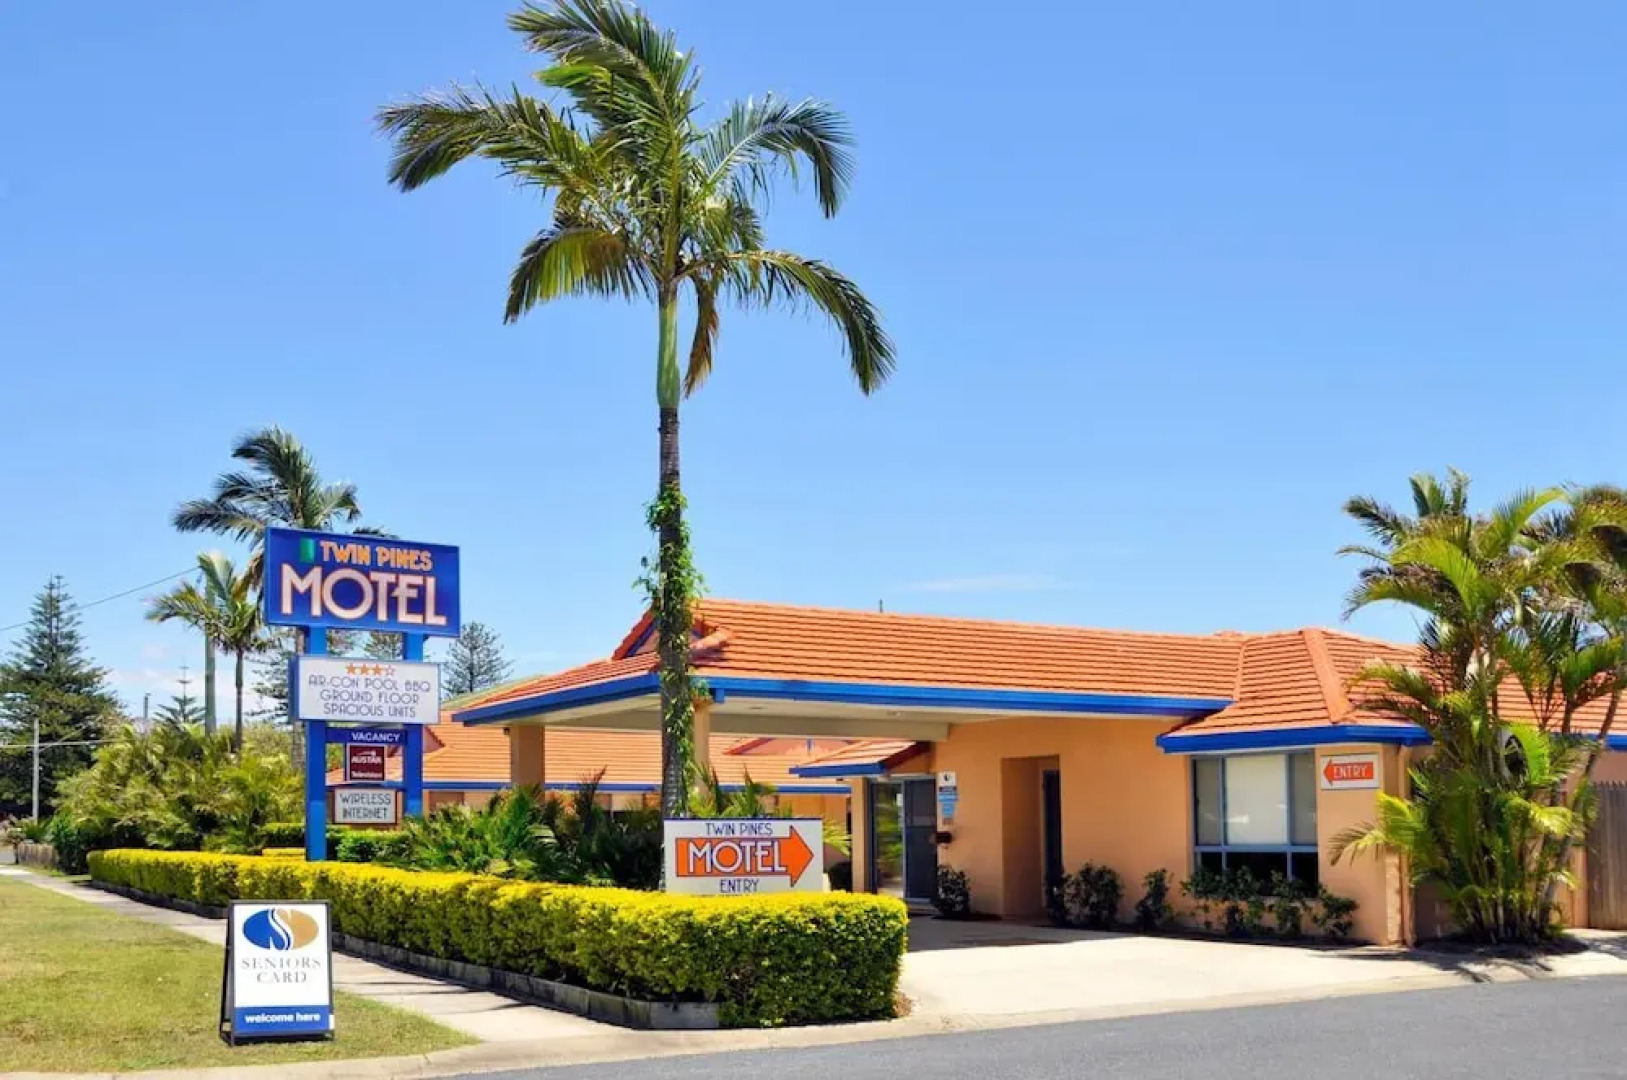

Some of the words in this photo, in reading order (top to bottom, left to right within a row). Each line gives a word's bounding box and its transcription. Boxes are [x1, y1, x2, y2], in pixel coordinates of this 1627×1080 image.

[320, 540, 370, 565] TWIN
[376, 547, 432, 571] PINES
[281, 563, 447, 625] MOTEL
[365, 678, 399, 691] POOL
[404, 680, 431, 692] BBQ
[320, 689, 373, 703] GROUND
[378, 693, 419, 704] FLOOR
[323, 702, 384, 717] SPACIOUS
[388, 706, 416, 718] UNITS
[351, 732, 400, 742] VACANCY
[1333, 765, 1368, 779] ENTRY
[340, 794, 391, 805] WIRELESS
[343, 807, 387, 818] INTERNET
[705, 822, 735, 835] TWIN
[739, 822, 773, 835] PINES
[688, 841, 787, 873] MOTEL
[720, 879, 759, 893] ENTRY
[241, 957, 321, 969] SENIORS
[257, 971, 307, 983] CARD
[245, 1013, 294, 1024] welcome
[295, 1012, 320, 1022] here
